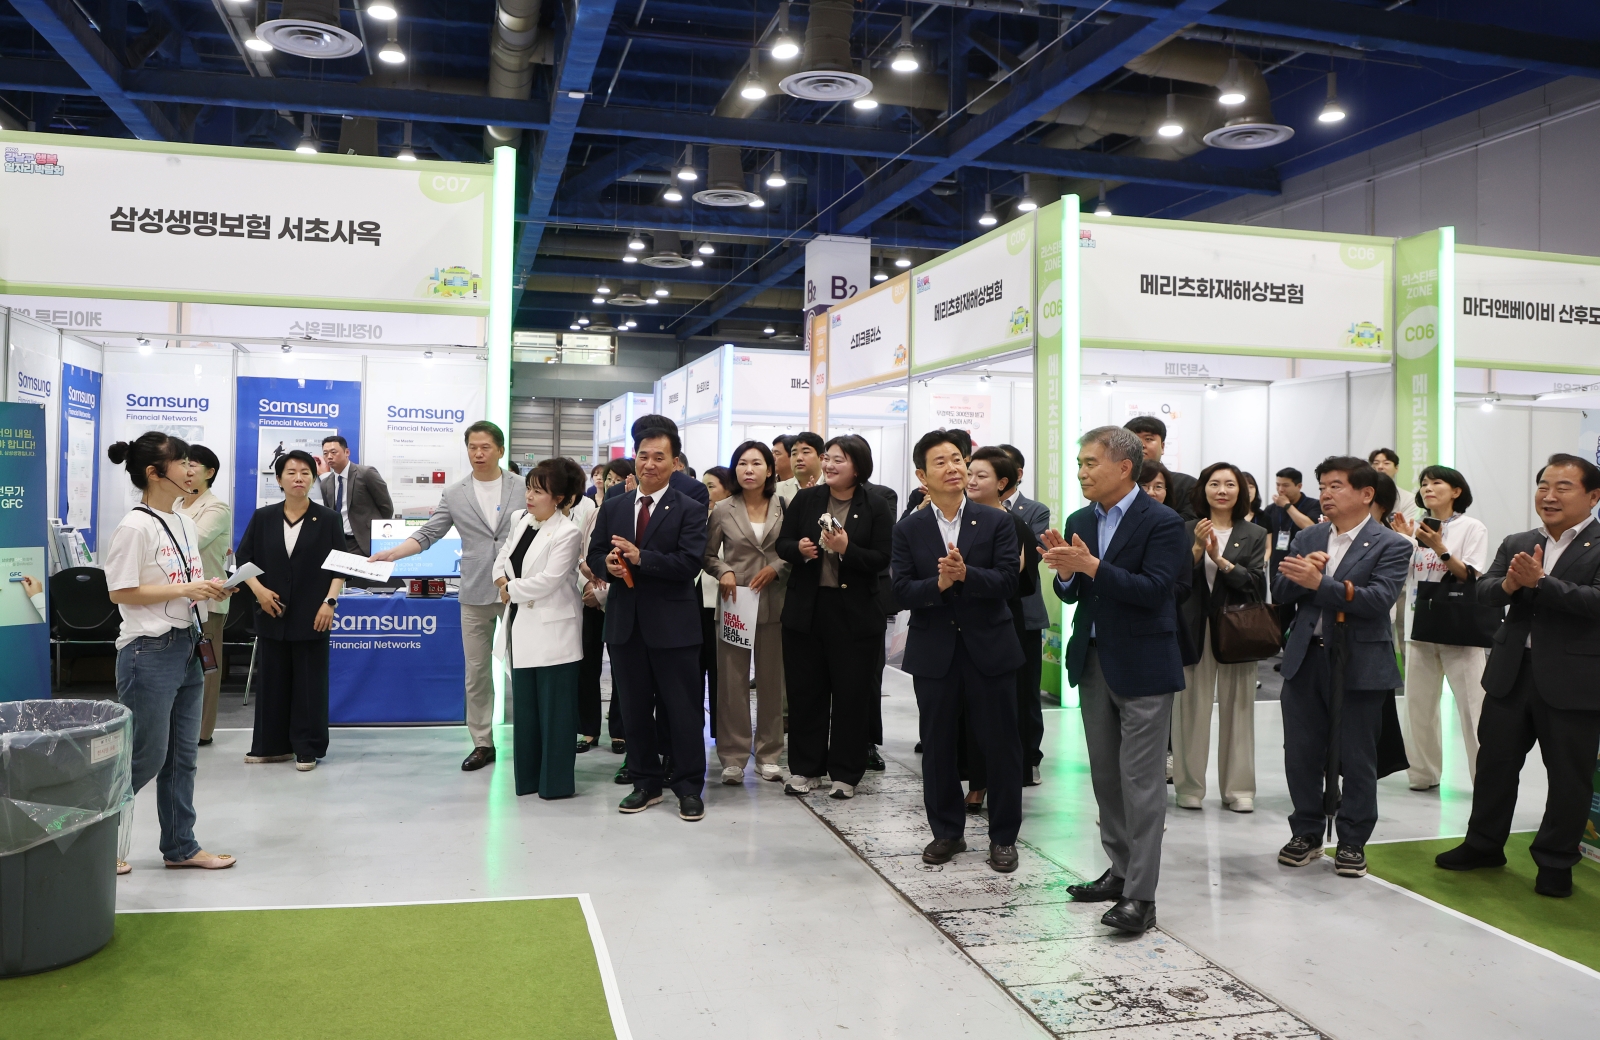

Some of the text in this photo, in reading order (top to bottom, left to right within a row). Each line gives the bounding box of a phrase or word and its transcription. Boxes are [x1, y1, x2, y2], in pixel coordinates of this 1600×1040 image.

[5, 152, 58, 166] 강남구 행복
[4, 162, 64, 176] 일자리 박람회
[432, 174, 470, 194] C07
[109, 206, 382, 246] 삼성생명보험 서초사옥
[1010, 228, 1025, 246] C06
[1347, 246, 1375, 260] C06
[1402, 269, 1438, 286] 리스타트
[1140, 273, 1304, 305] 메리츠화재해상보험
[1406, 284, 1433, 299] ZONE
[934, 279, 1003, 321] 메리츠화재해상보험
[1463, 296, 1555, 322] 마더앤베이비
[850, 325, 882, 349] 스파크플러스
[1405, 323, 1435, 342] C06
[18, 371, 51, 397] Samsung
[68, 385, 95, 409] Samsung
[126, 393, 209, 412] Samsung
[258, 398, 339, 418] Samsung
[387, 405, 465, 423] Samsung
[126, 413, 198, 422] Financial Networks
[259, 418, 328, 428] Financial Networks
[14, 429, 35, 439] 내일,
[387, 424, 454, 433] Financial Networks
[8, 440, 36, 450] 합니다!
[1, 498, 23, 509] GFC
[330, 612, 437, 635] Samsung
[724, 611, 741, 622] REAL
[724, 617, 748, 631] WORK.
[723, 625, 740, 637] REAL
[723, 632, 752, 646] PEOPLE.
[373, 640, 421, 649] Networks
